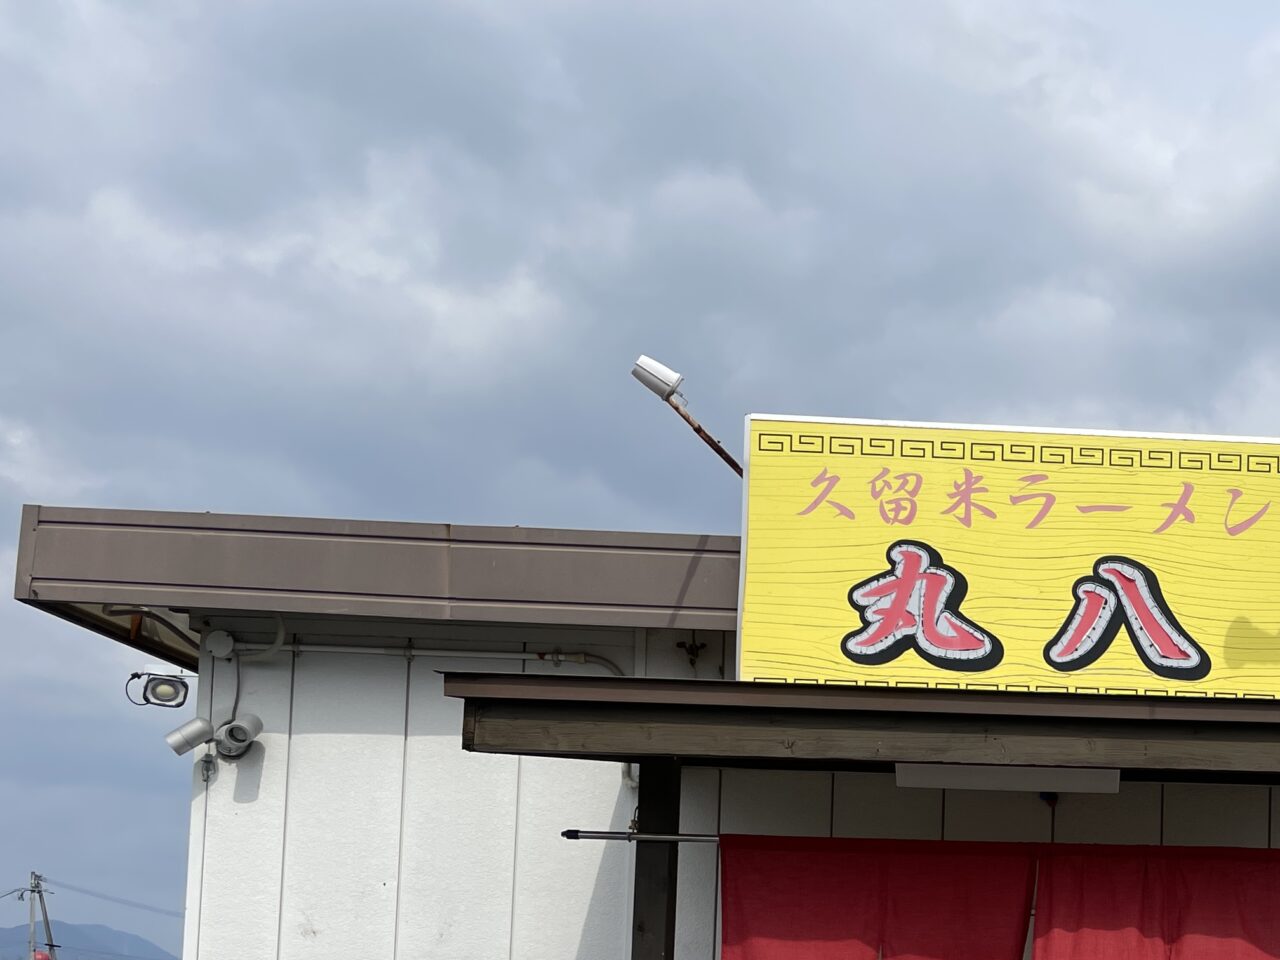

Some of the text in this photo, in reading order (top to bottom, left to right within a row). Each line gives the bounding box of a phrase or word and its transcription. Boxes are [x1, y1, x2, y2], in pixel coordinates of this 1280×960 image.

[796, 466, 1273, 537] 久留米ラーメン
